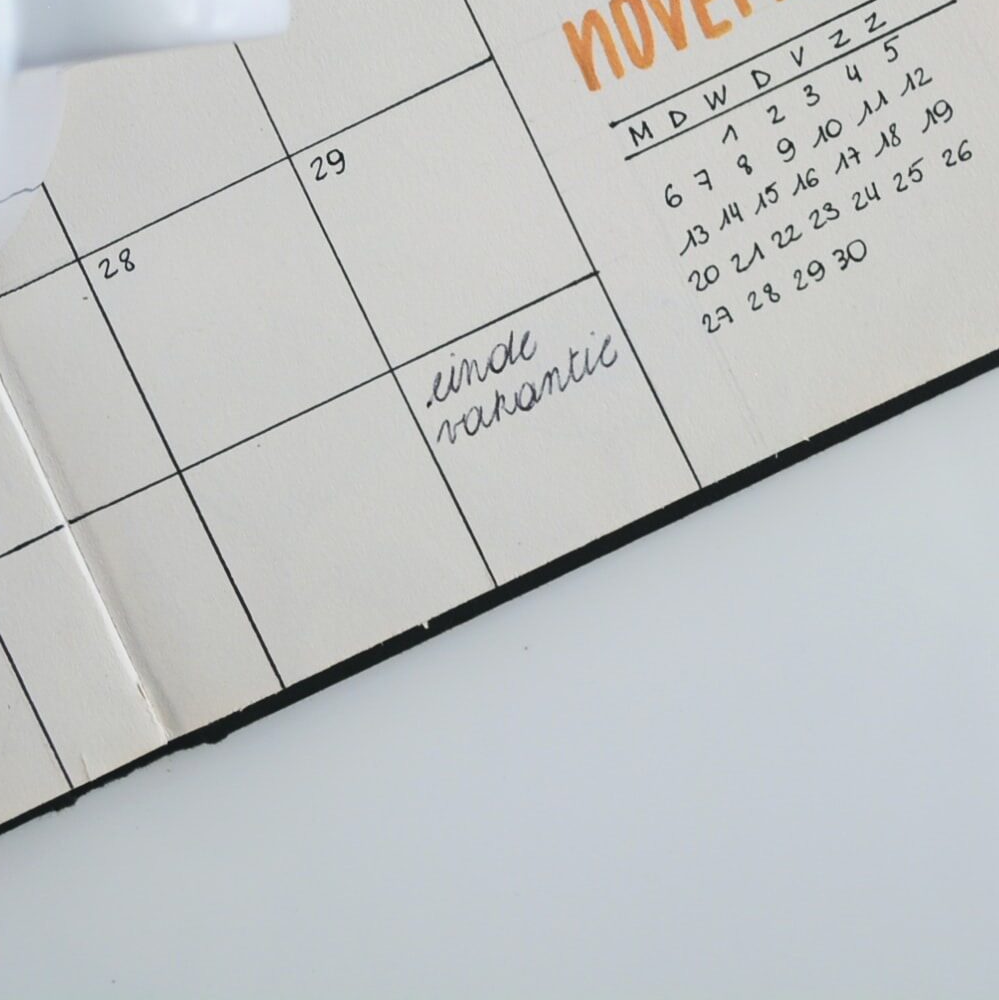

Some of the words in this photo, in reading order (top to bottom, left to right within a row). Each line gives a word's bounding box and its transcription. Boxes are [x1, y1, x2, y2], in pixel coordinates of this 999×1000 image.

[628, 122, 654, 147] M
[668, 109, 689, 130] D
[703, 85, 729, 111] W
[751, 69, 771, 90] D
[790, 47, 805, 67] V
[829, 29, 851, 48] Z
[864, 12, 887, 33] Z
[722, 125, 738, 145] 1
[767, 105, 785, 125] 2
[804, 84, 820, 106] 3
[845, 63, 863, 84] 4
[884, 34, 899, 63] 5
[310, 148, 347, 182] 29
[664, 184, 683, 208] 6
[693, 169, 713, 191] 7
[737, 155, 753, 176] 8
[777, 138, 796, 163] 9
[812, 119, 843, 149] 10
[856, 90, 888, 127] 11
[899, 67, 933, 97] 12
[679, 225, 710, 257] 13
[719, 203, 745, 231] 14
[755, 182, 780, 215] 15
[792, 168, 820, 197] 16
[834, 146, 863, 176] 17
[874, 123, 903, 158] 18
[920, 99, 953, 134] 19
[97, 248, 137, 281] 28
[688, 265, 720, 292] 20
[731, 243, 765, 273] 21
[770, 223, 803, 249] 22
[809, 202, 840, 230] 23
[851, 182, 881, 211] 24
[892, 157, 925, 193] 25
[942, 139, 973, 169] 26
[702, 306, 735, 334] 27
[747, 284, 781, 312] 28
[793, 260, 826, 291] 29
[832, 239, 868, 271] 30
[426, 329, 537, 409] einde
[436, 331, 619, 445] vakantie
